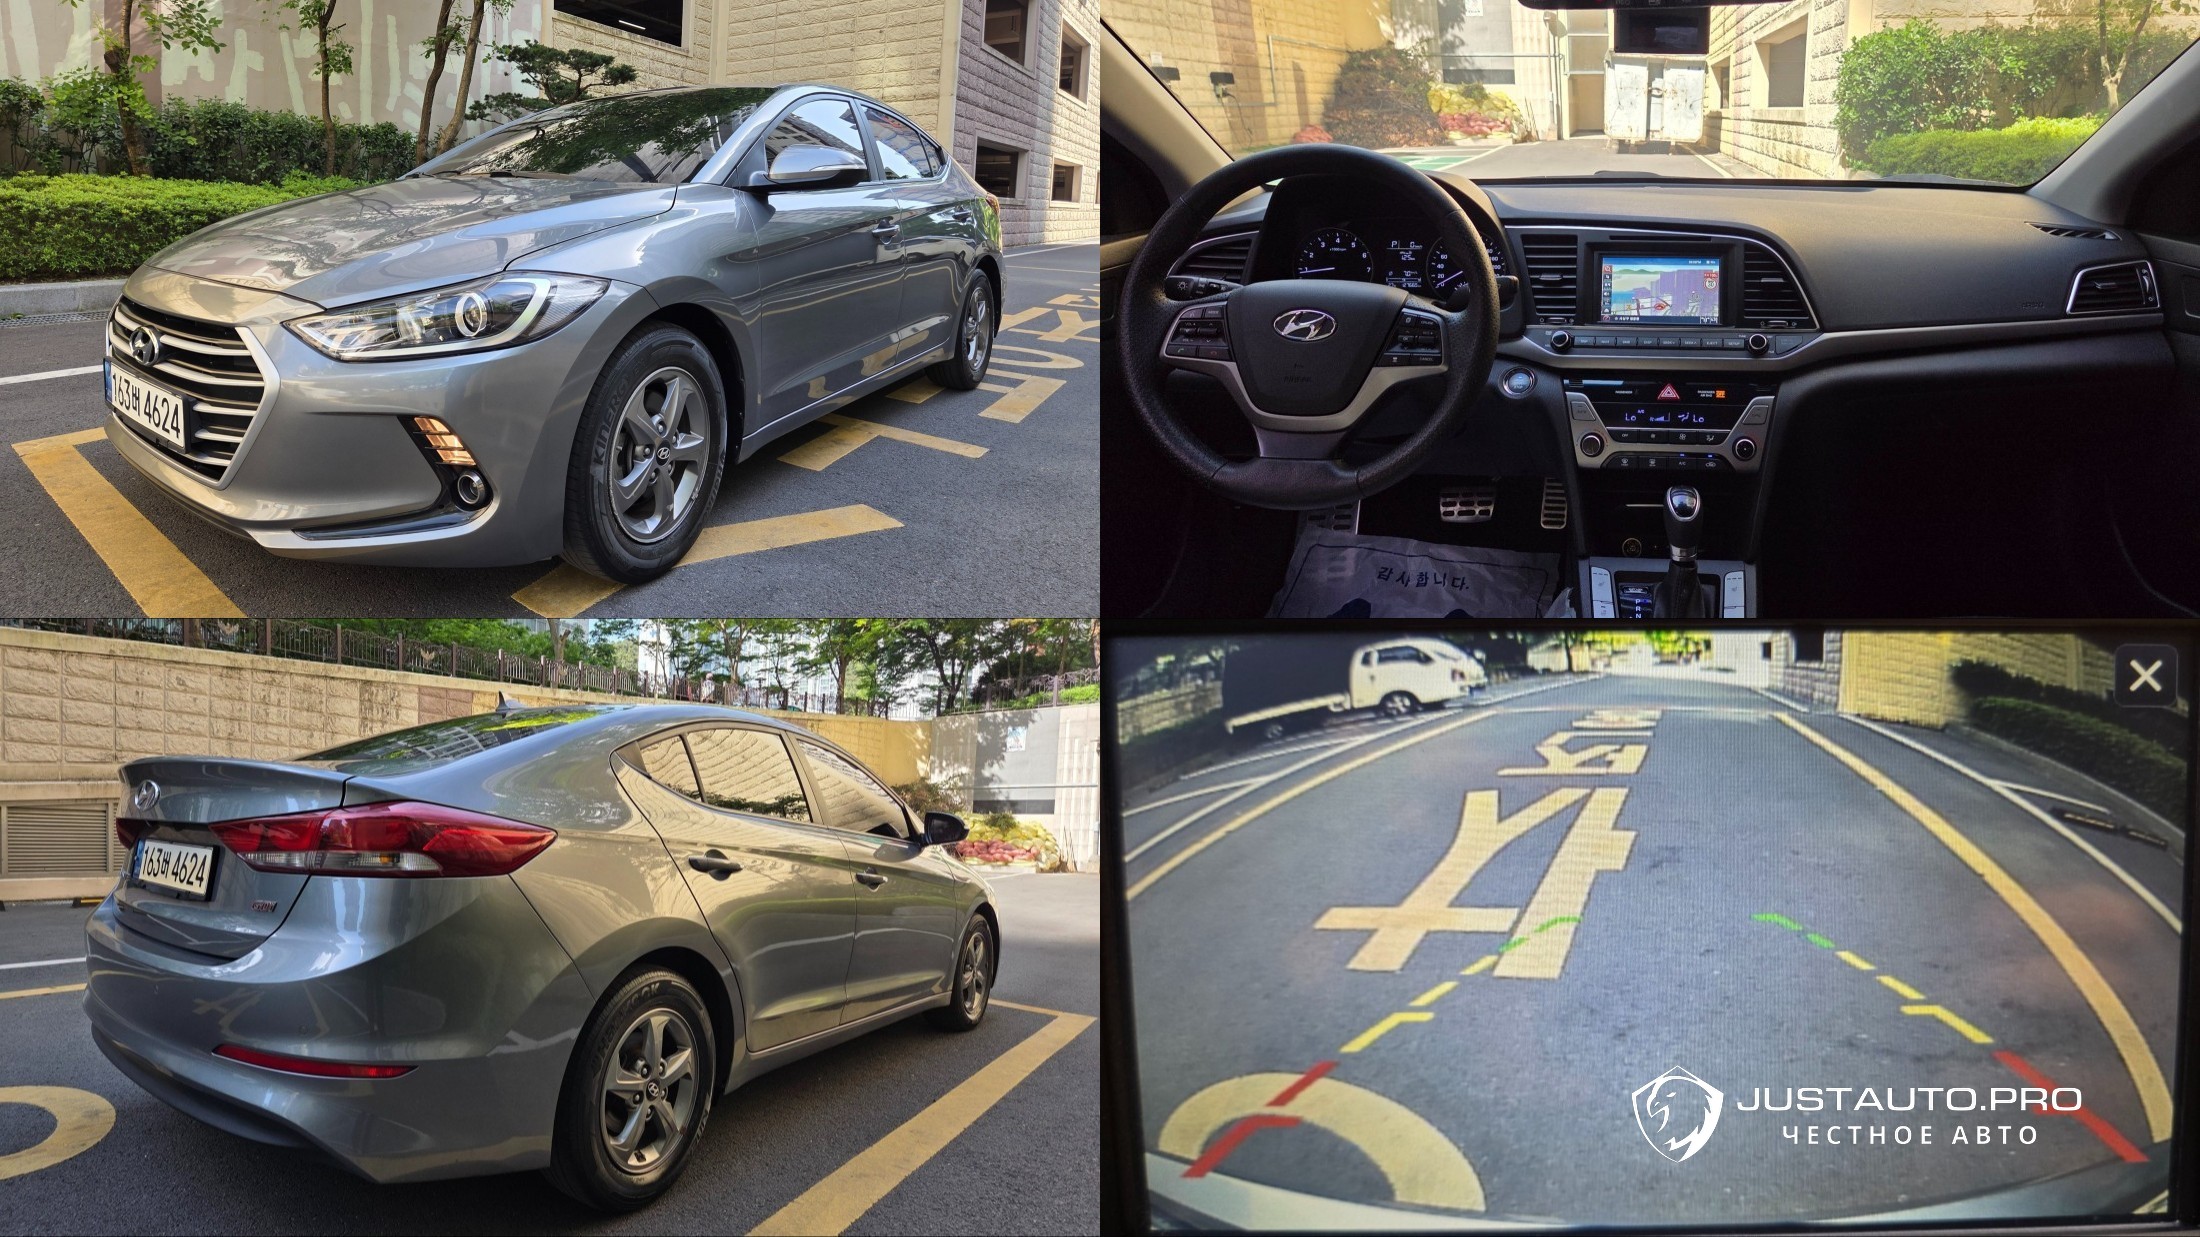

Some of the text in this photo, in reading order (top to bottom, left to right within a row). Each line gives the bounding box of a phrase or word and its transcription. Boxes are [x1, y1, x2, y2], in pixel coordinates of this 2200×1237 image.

[143, 389, 181, 440] 4624
[1376, 566, 1470, 592] 감사합니다.
[172, 850, 207, 888] 4624
